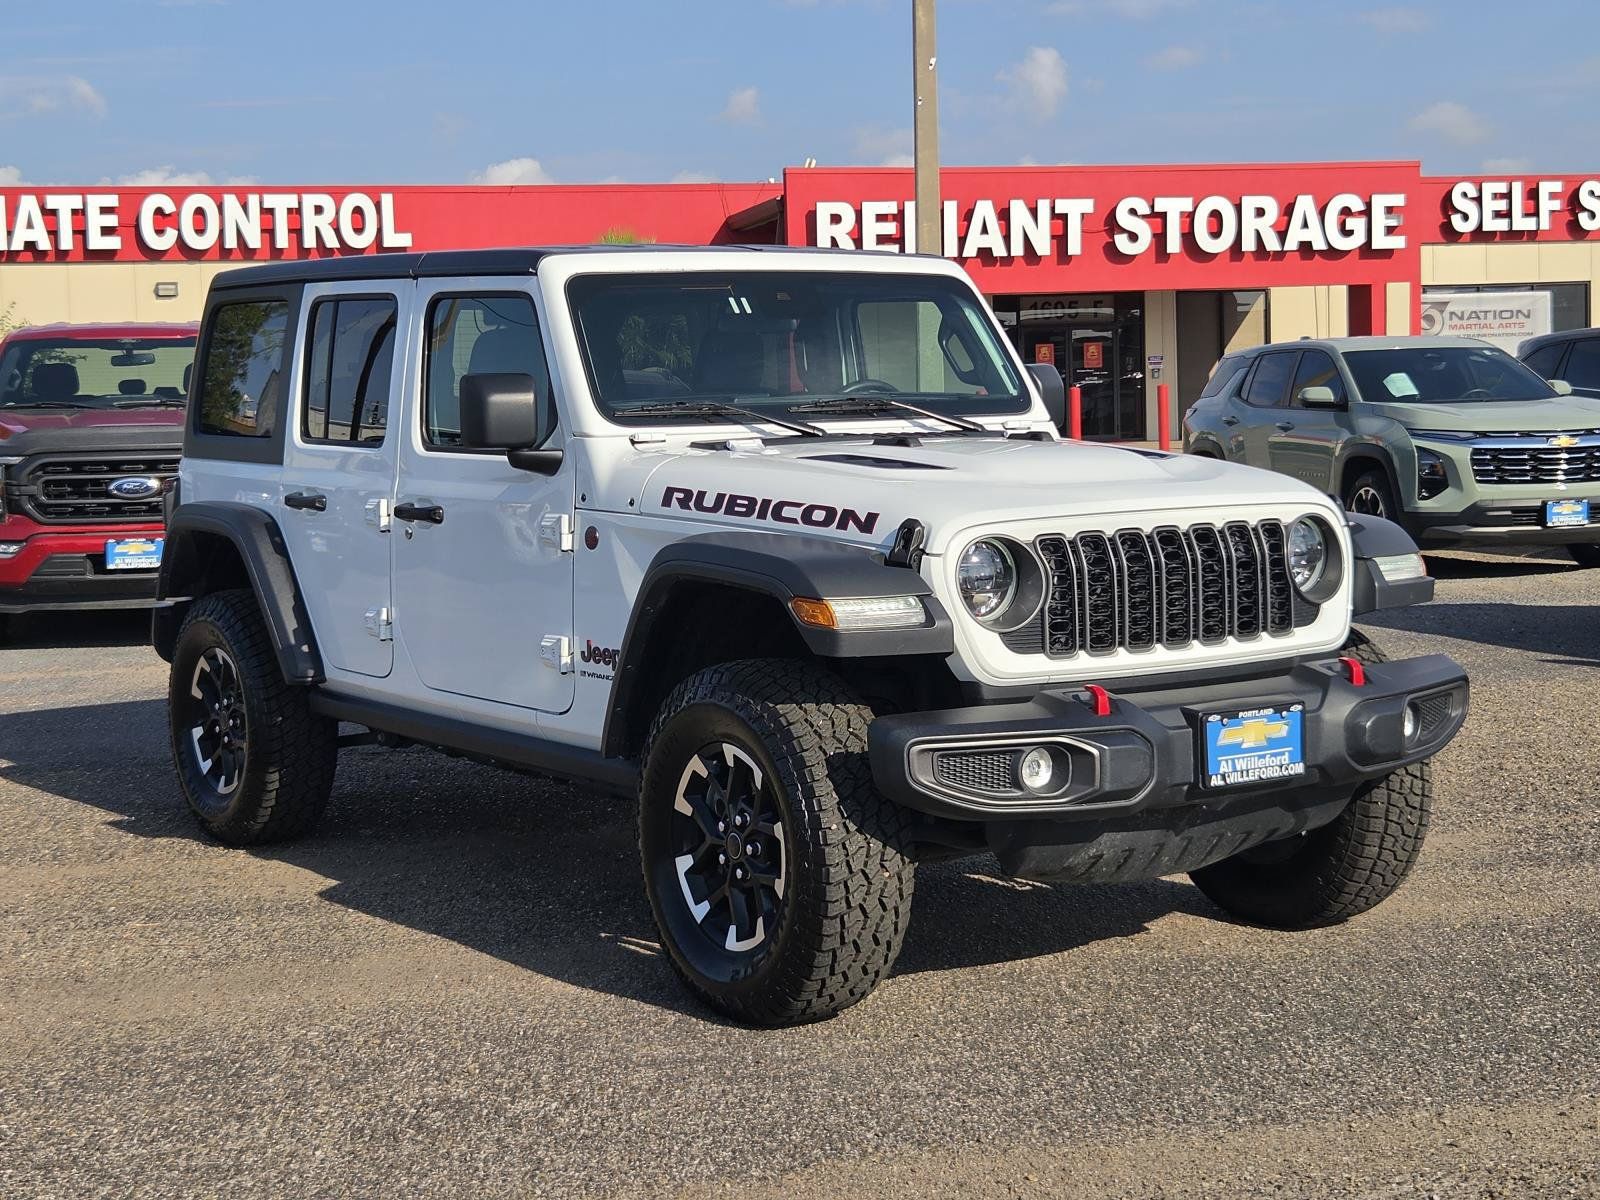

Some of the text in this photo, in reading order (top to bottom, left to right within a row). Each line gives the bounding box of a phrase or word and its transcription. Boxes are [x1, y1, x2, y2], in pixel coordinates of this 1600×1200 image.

[1451, 181, 1563, 232] SELF
[0, 193, 413, 251] ATE CONTROL
[1114, 194, 1406, 255] STORAGE
[1448, 322, 1494, 331] MARTIAL
[1449, 309, 1531, 321] NATION
[661, 486, 880, 535] RUBICON
[580, 639, 621, 672] Jeep
[1238, 708, 1274, 718] PORTLAND
[1210, 763, 1304, 787] AL WILLEFORD.COM
[1219, 752, 1289, 773] Al Willeford
